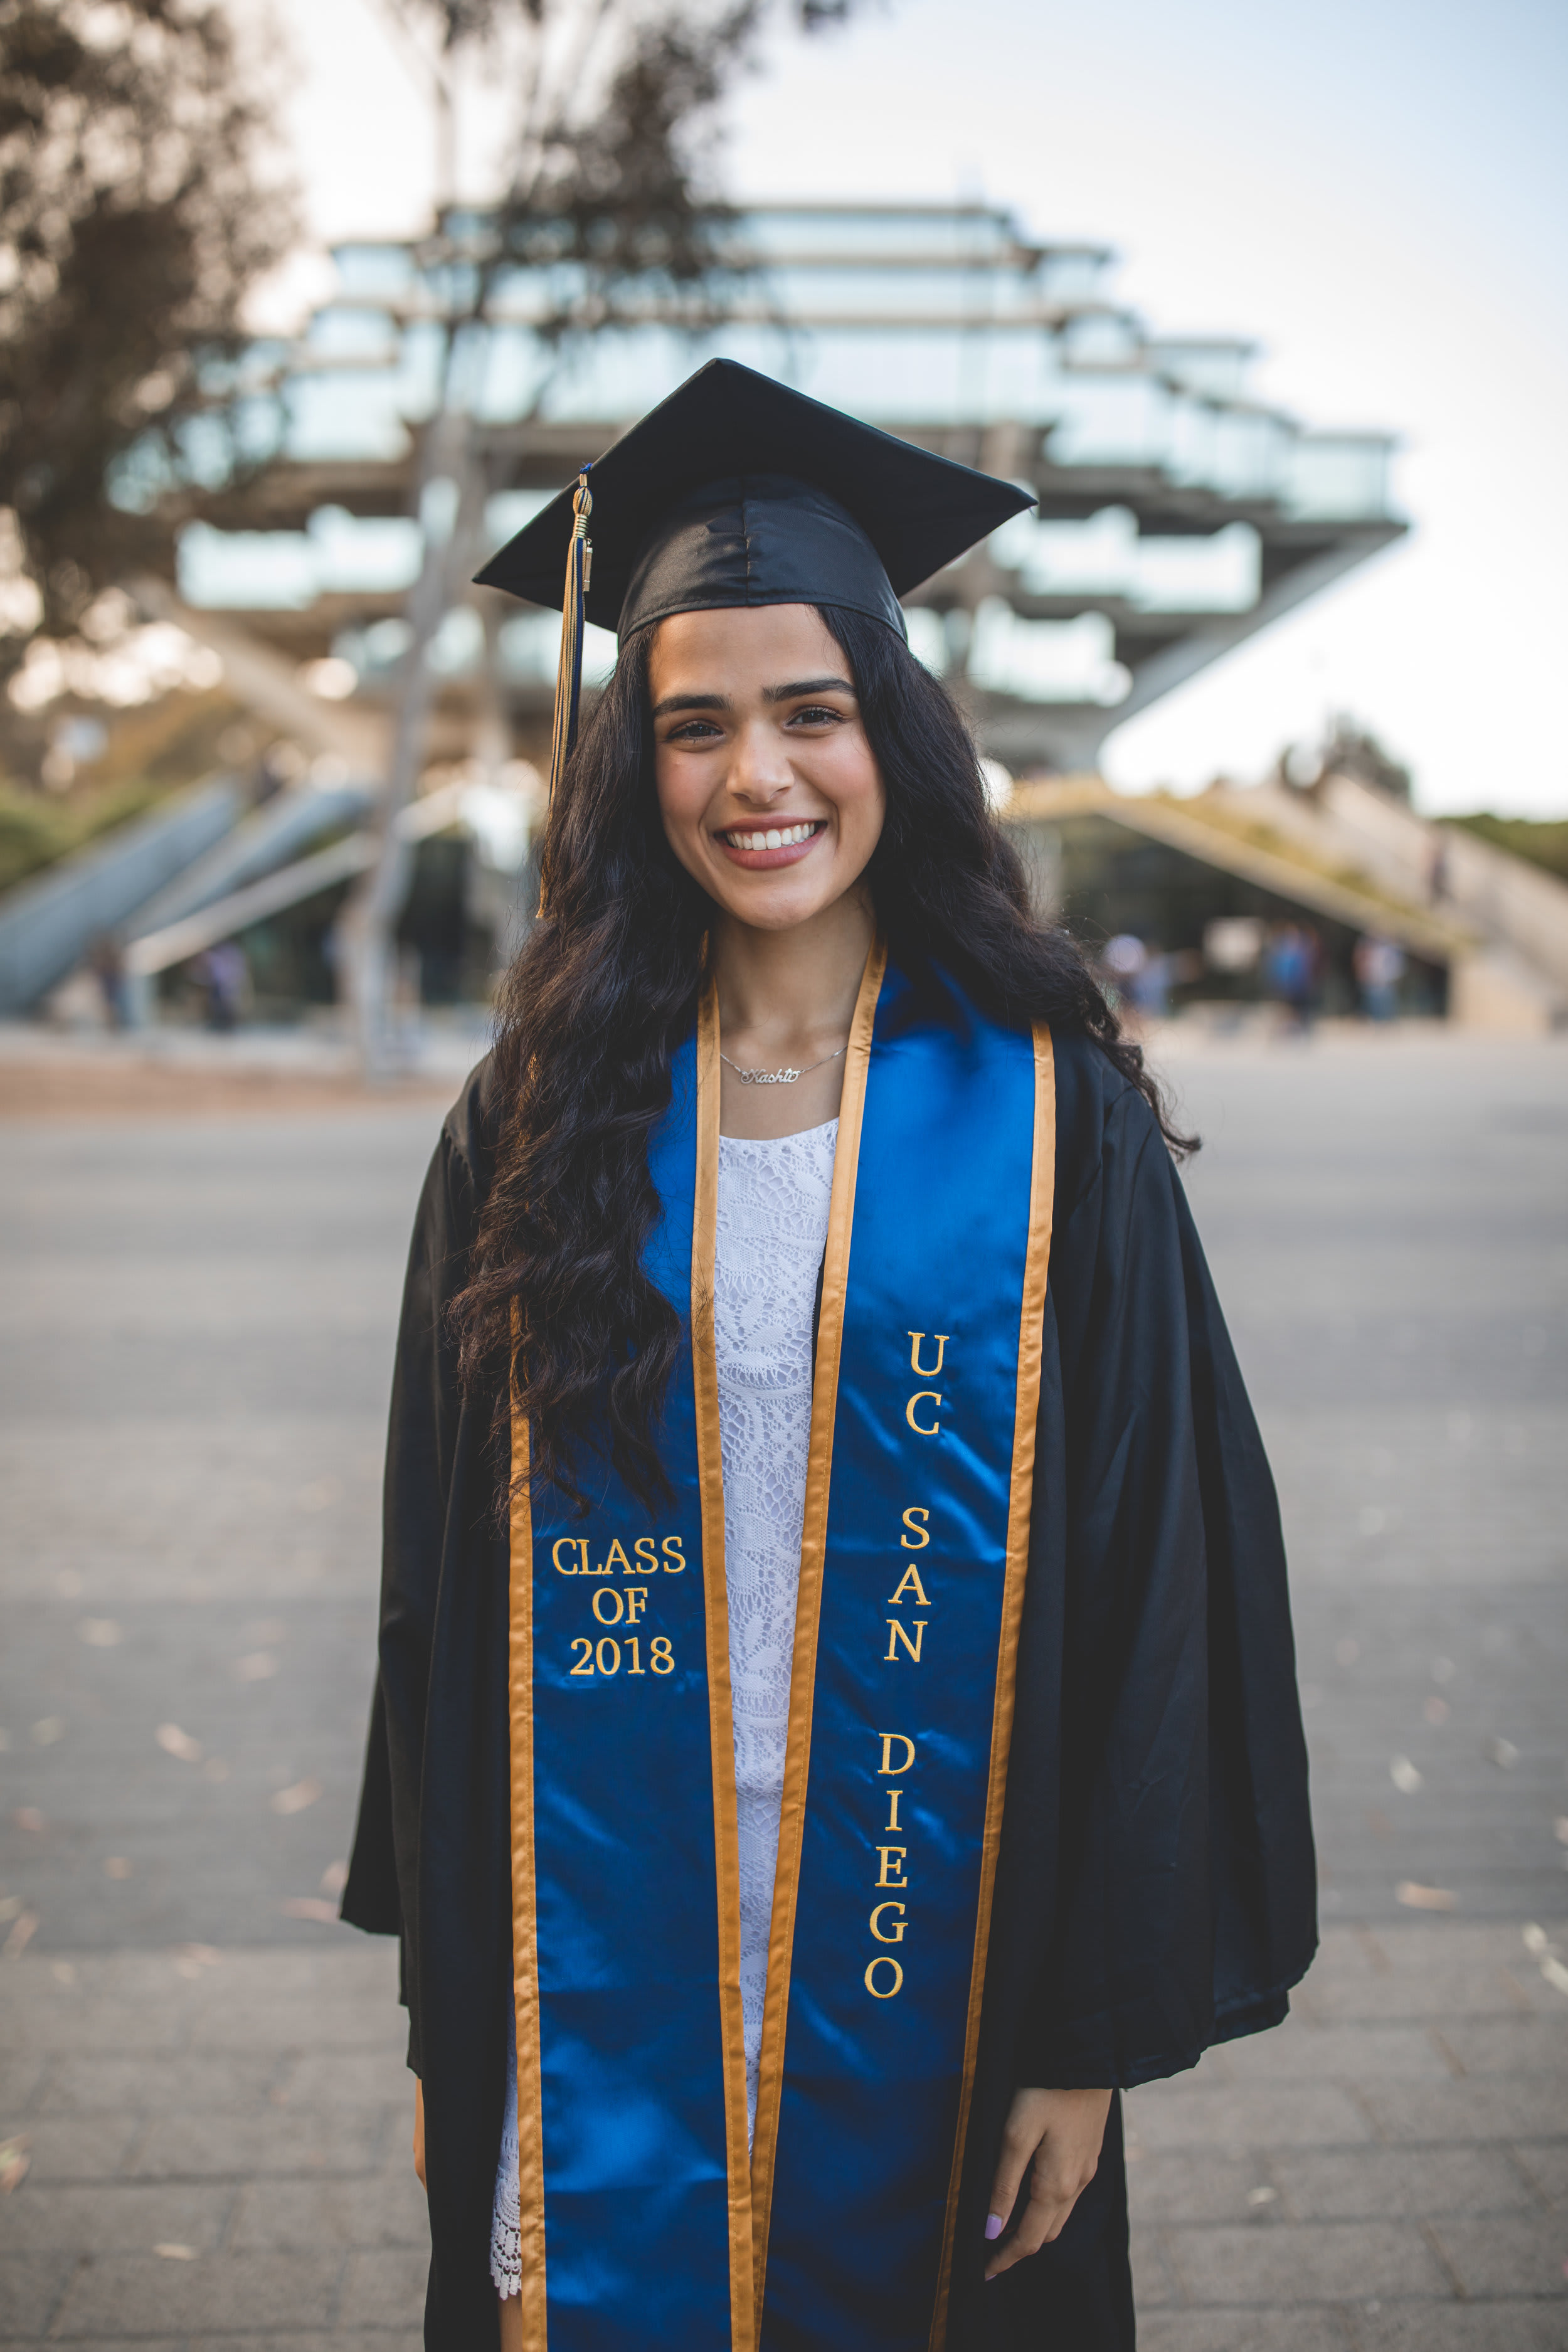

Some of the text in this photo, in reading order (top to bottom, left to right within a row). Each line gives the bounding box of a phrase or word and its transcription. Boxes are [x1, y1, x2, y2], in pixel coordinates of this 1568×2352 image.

[553, 1537, 686, 1575] CLASS
[592, 1587, 648, 1625] OF
[569, 1637, 675, 1675] 2018
[864, 1330, 950, 1999] UC SAN DIEGO
